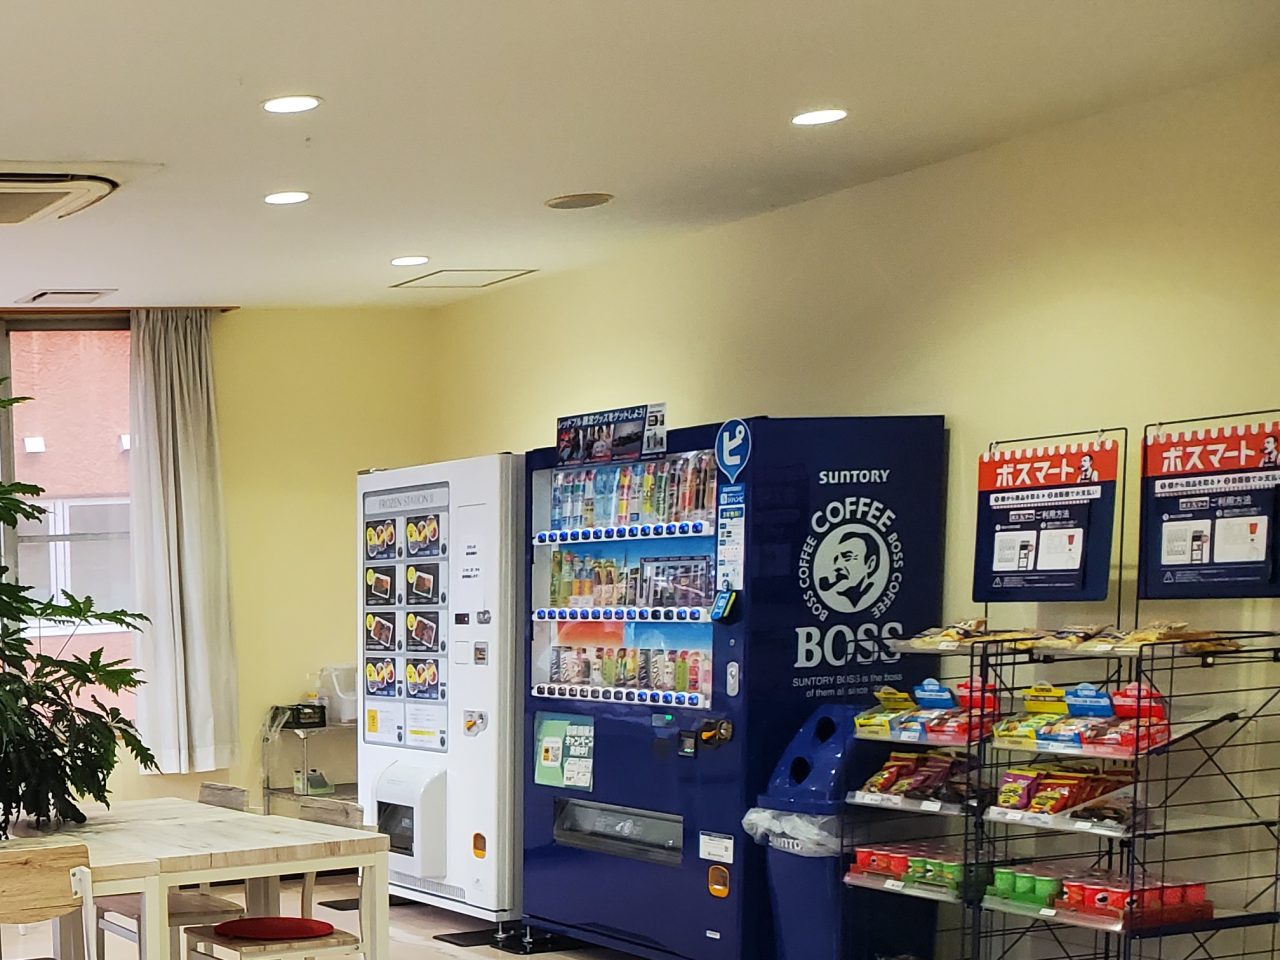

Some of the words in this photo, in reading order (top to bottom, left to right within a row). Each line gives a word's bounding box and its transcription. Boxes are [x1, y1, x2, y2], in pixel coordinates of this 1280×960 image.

[723, 424, 745, 465] ピ
[1162, 440, 1255, 473] ボスマート
[819, 469, 891, 485] SUNTORY
[996, 458, 1074, 487] ボスマート
[811, 496, 897, 534] COFFEE
[799, 535, 818, 588] COFFEE
[887, 532, 904, 569] BOSS
[803, 589, 829, 622] BOSS
[873, 574, 903, 620] COFFEE
[793, 622, 904, 668] BOSS
[792, 676, 834, 688] SUNTORY
